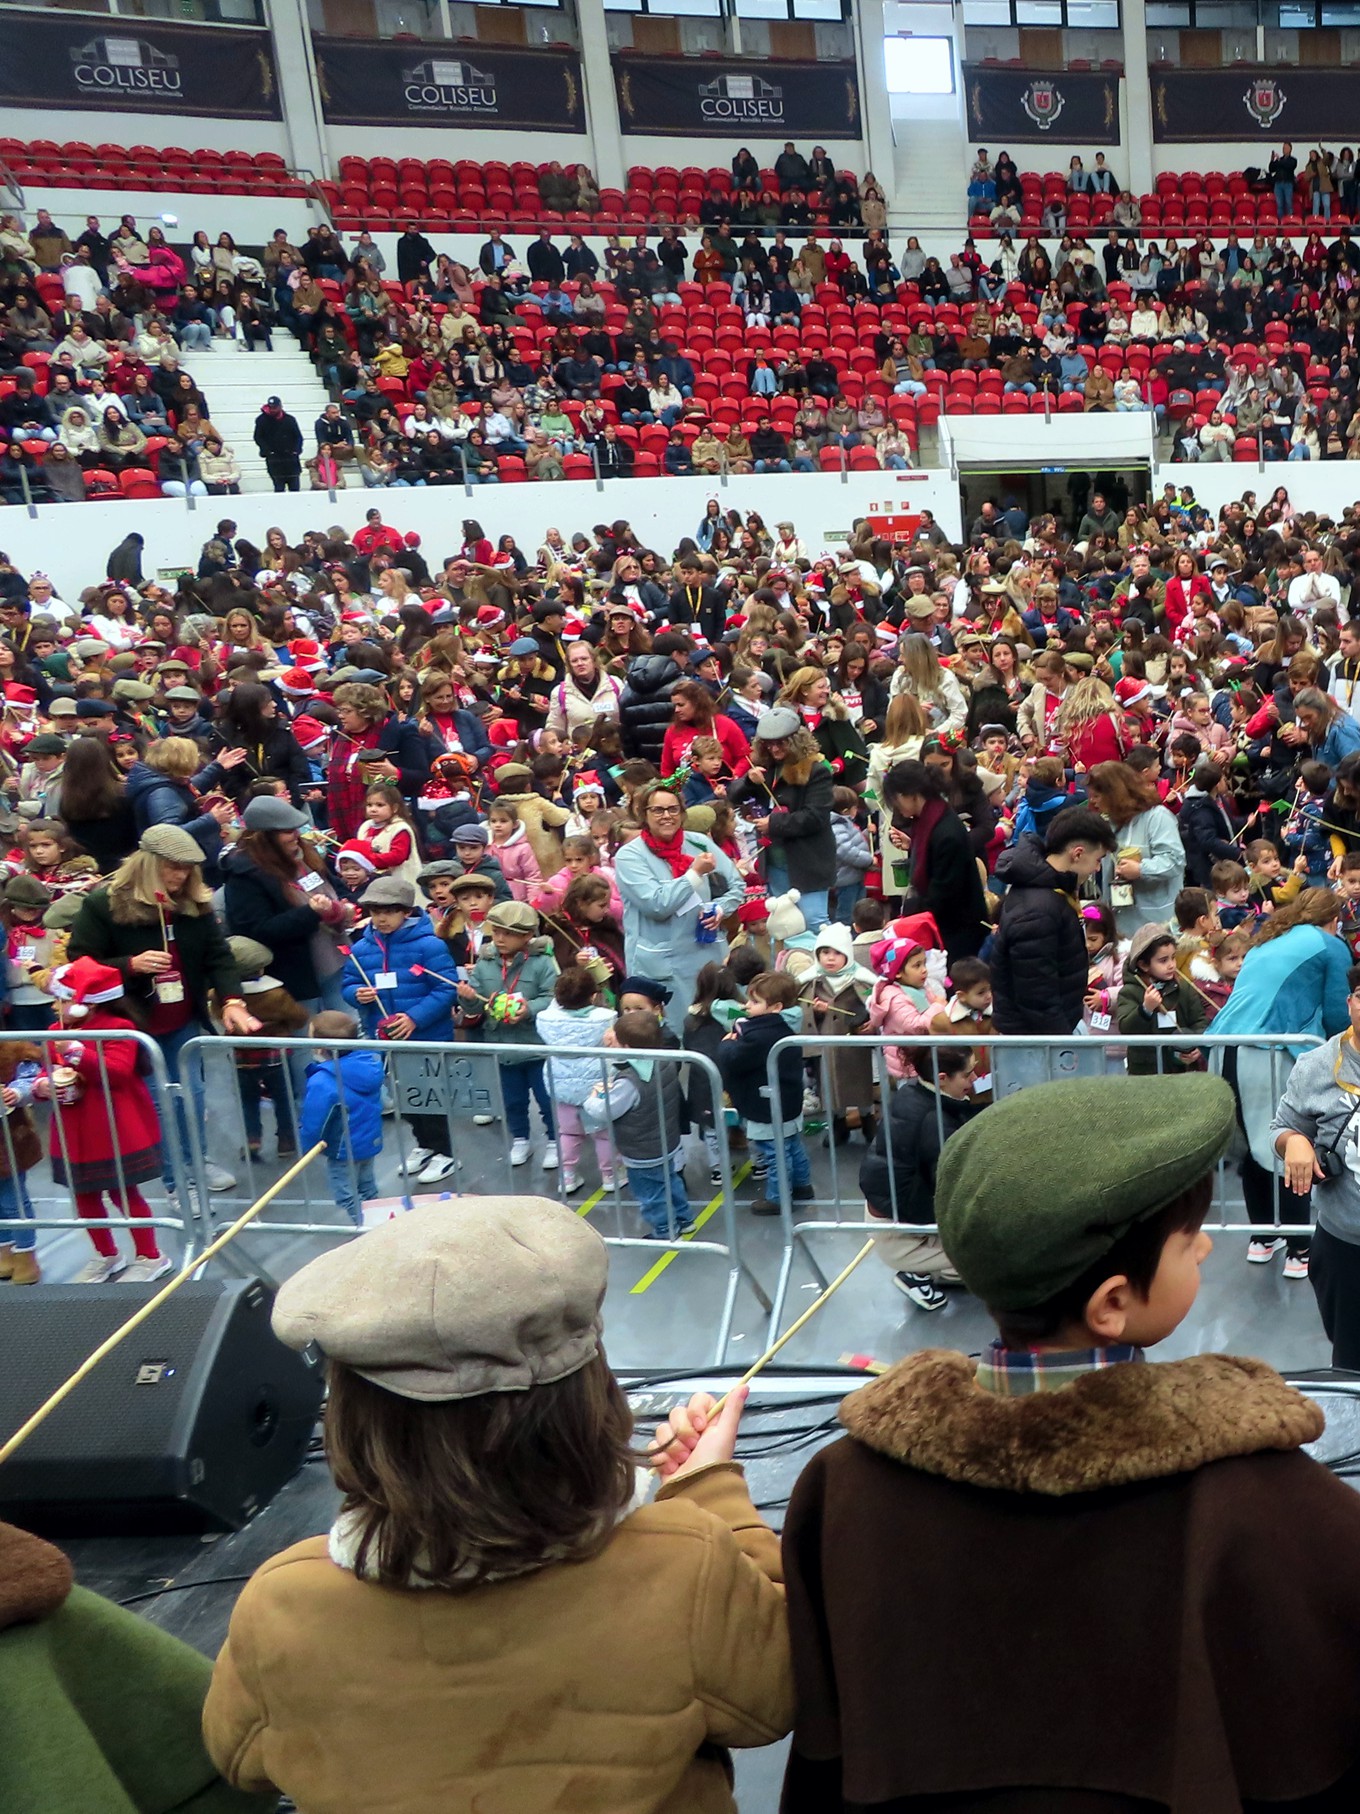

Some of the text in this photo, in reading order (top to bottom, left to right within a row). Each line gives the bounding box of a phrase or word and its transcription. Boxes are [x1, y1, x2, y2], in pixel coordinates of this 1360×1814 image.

[75, 65, 180, 89] COLISEU
[405, 85, 496, 105] COLISEU
[701, 99, 783, 117] COLISEU
[1092, 1014, 1109, 1028] 318
